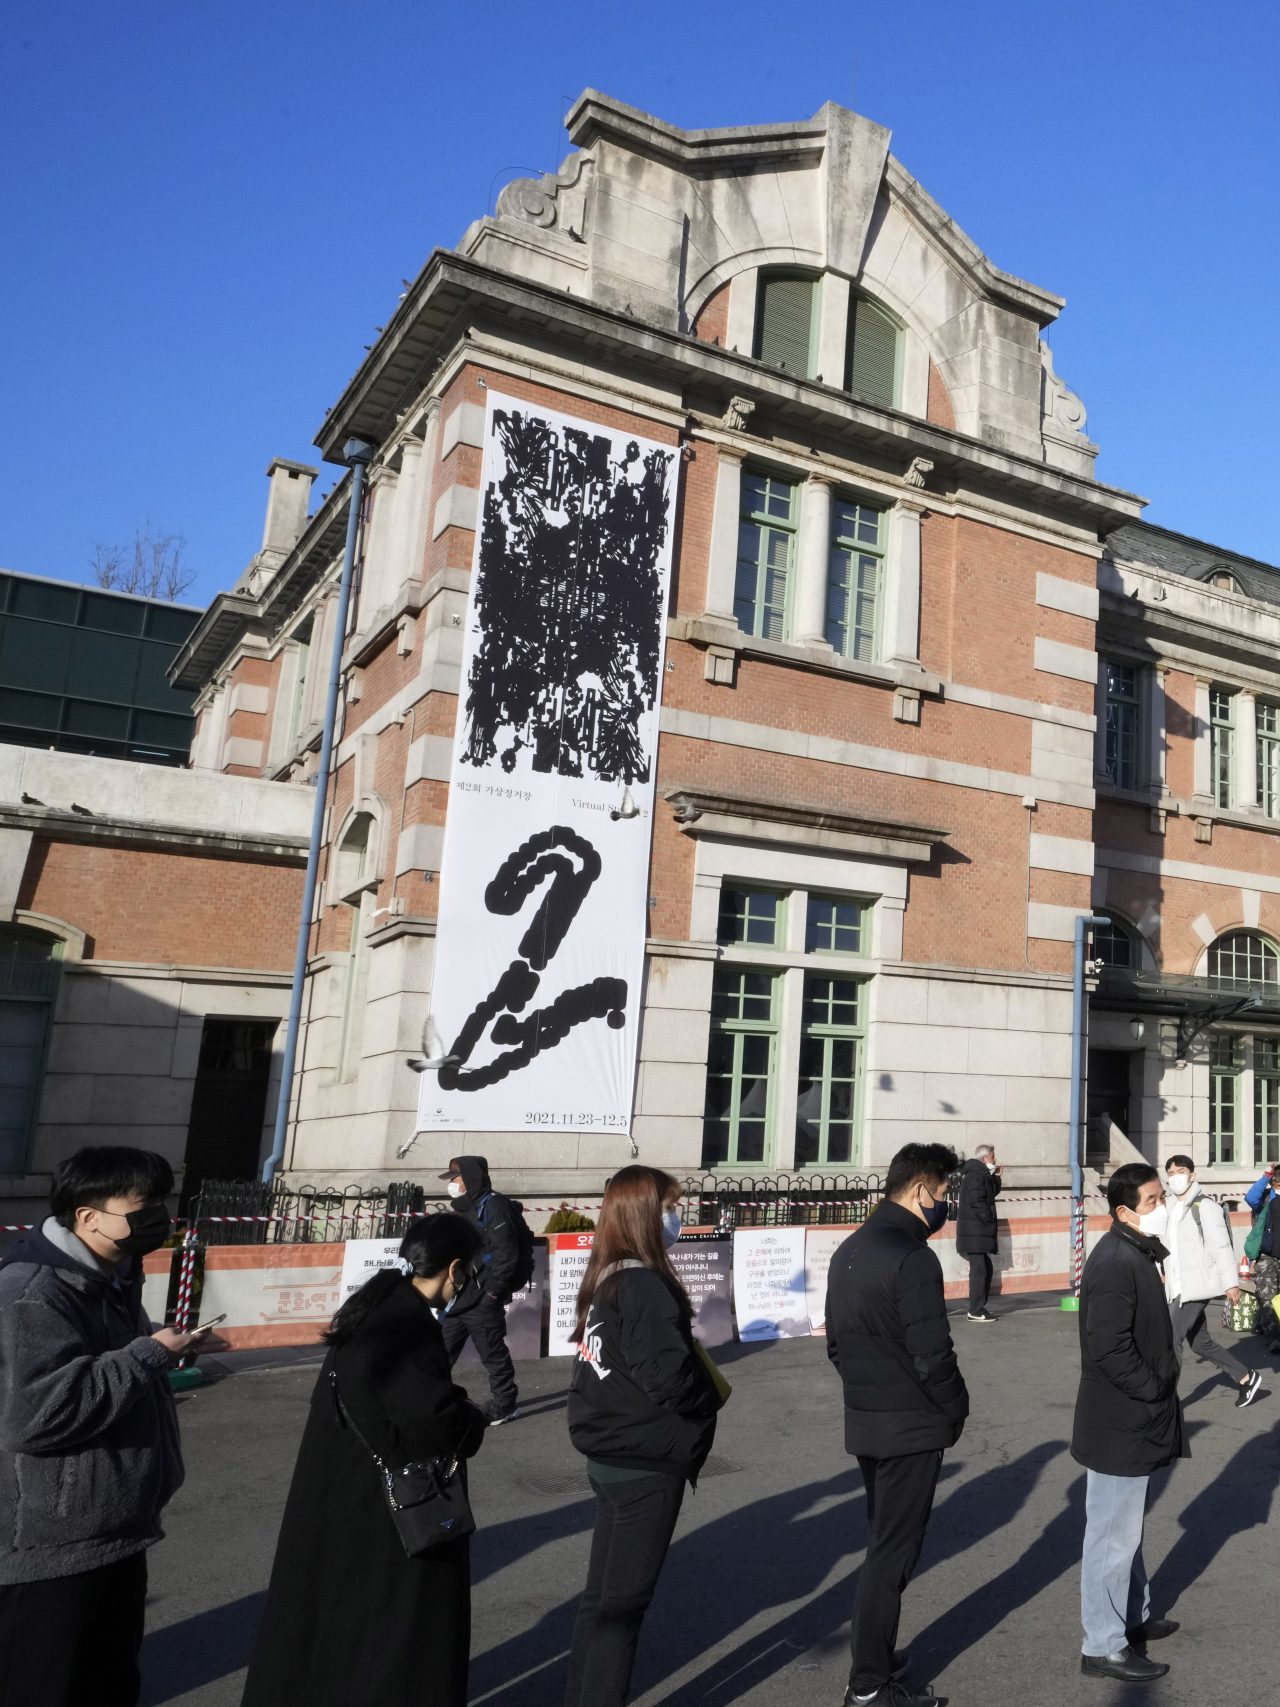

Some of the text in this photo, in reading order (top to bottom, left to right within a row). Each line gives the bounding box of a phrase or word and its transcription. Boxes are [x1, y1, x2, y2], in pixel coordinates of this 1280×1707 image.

[456, 781, 532, 801] 제2회 가상정거장
[572, 799, 605, 811] Virtual
[363, 1258, 395, 1267] 하나님을
[561, 1257, 576, 1265] 내가
[559, 1282, 575, 1290] 그가
[278, 1291, 327, 1314] 문화역
